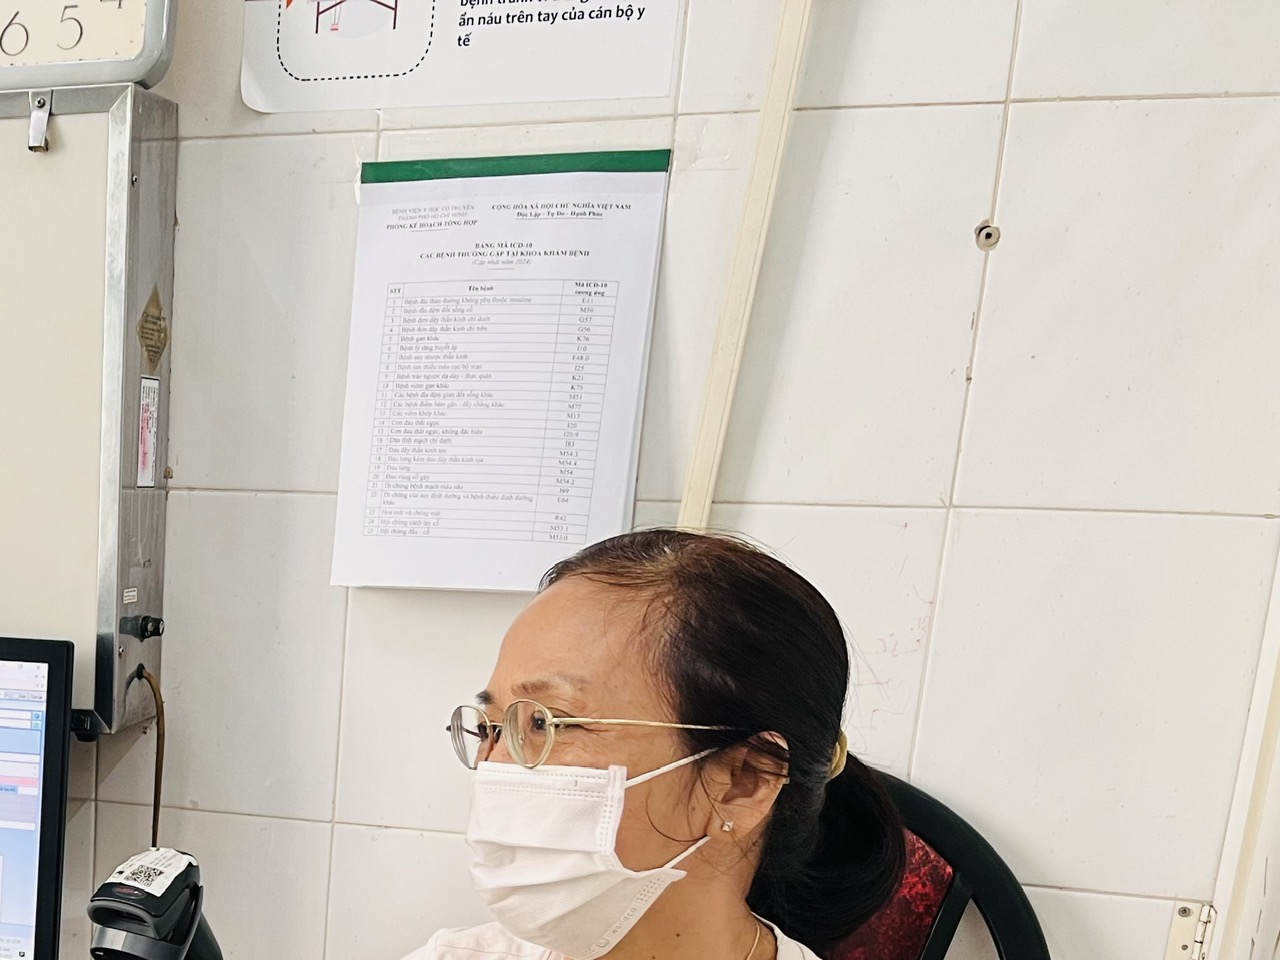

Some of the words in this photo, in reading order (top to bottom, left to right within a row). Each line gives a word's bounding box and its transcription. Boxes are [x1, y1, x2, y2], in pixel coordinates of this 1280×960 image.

[458, 12, 474, 26] ẩn
[477, 12, 502, 25] náu
[506, 11, 533, 23] trên
[537, 11, 558, 25] tay
[561, 7, 585, 20] của
[588, 6, 612, 19] cán
[615, 4, 633, 20] bộ
[637, 6, 646, 20] y
[0, 10, 29, 56] 6
[56, 4, 83, 50] 5
[457, 32, 472, 47] tế
[386, 222, 407, 230] PHÒNG
[419, 220, 442, 228] HOẠCH
[444, 219, 461, 227] TỔNG
[475, 241, 494, 249] BẢNG
[497, 241, 507, 249] MÃ
[509, 241, 533, 249] ICD-10
[506, 250, 518, 258] TẠI
[520, 250, 541, 258] KHOA
[543, 249, 567, 257] KHÁM
[568, 249, 590, 257] BỆNH
